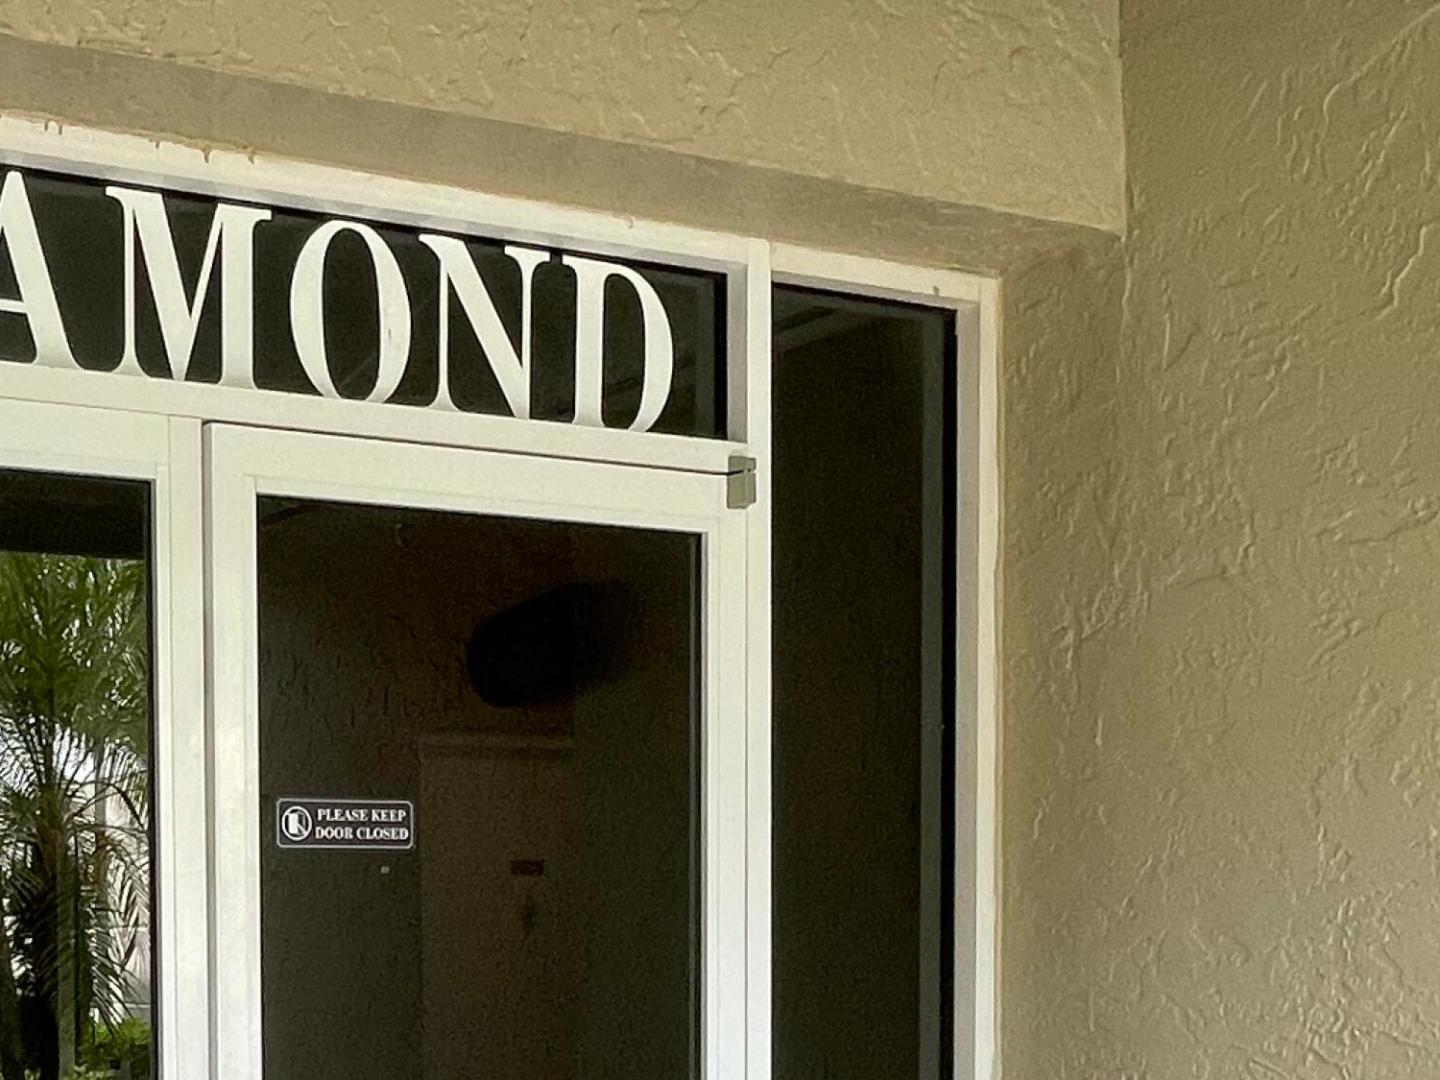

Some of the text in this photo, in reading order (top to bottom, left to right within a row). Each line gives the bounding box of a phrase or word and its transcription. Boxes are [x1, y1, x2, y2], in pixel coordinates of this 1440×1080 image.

[317, 808, 407, 822] PLEASE KEEP
[315, 826, 409, 840] DOOR CLOSED
